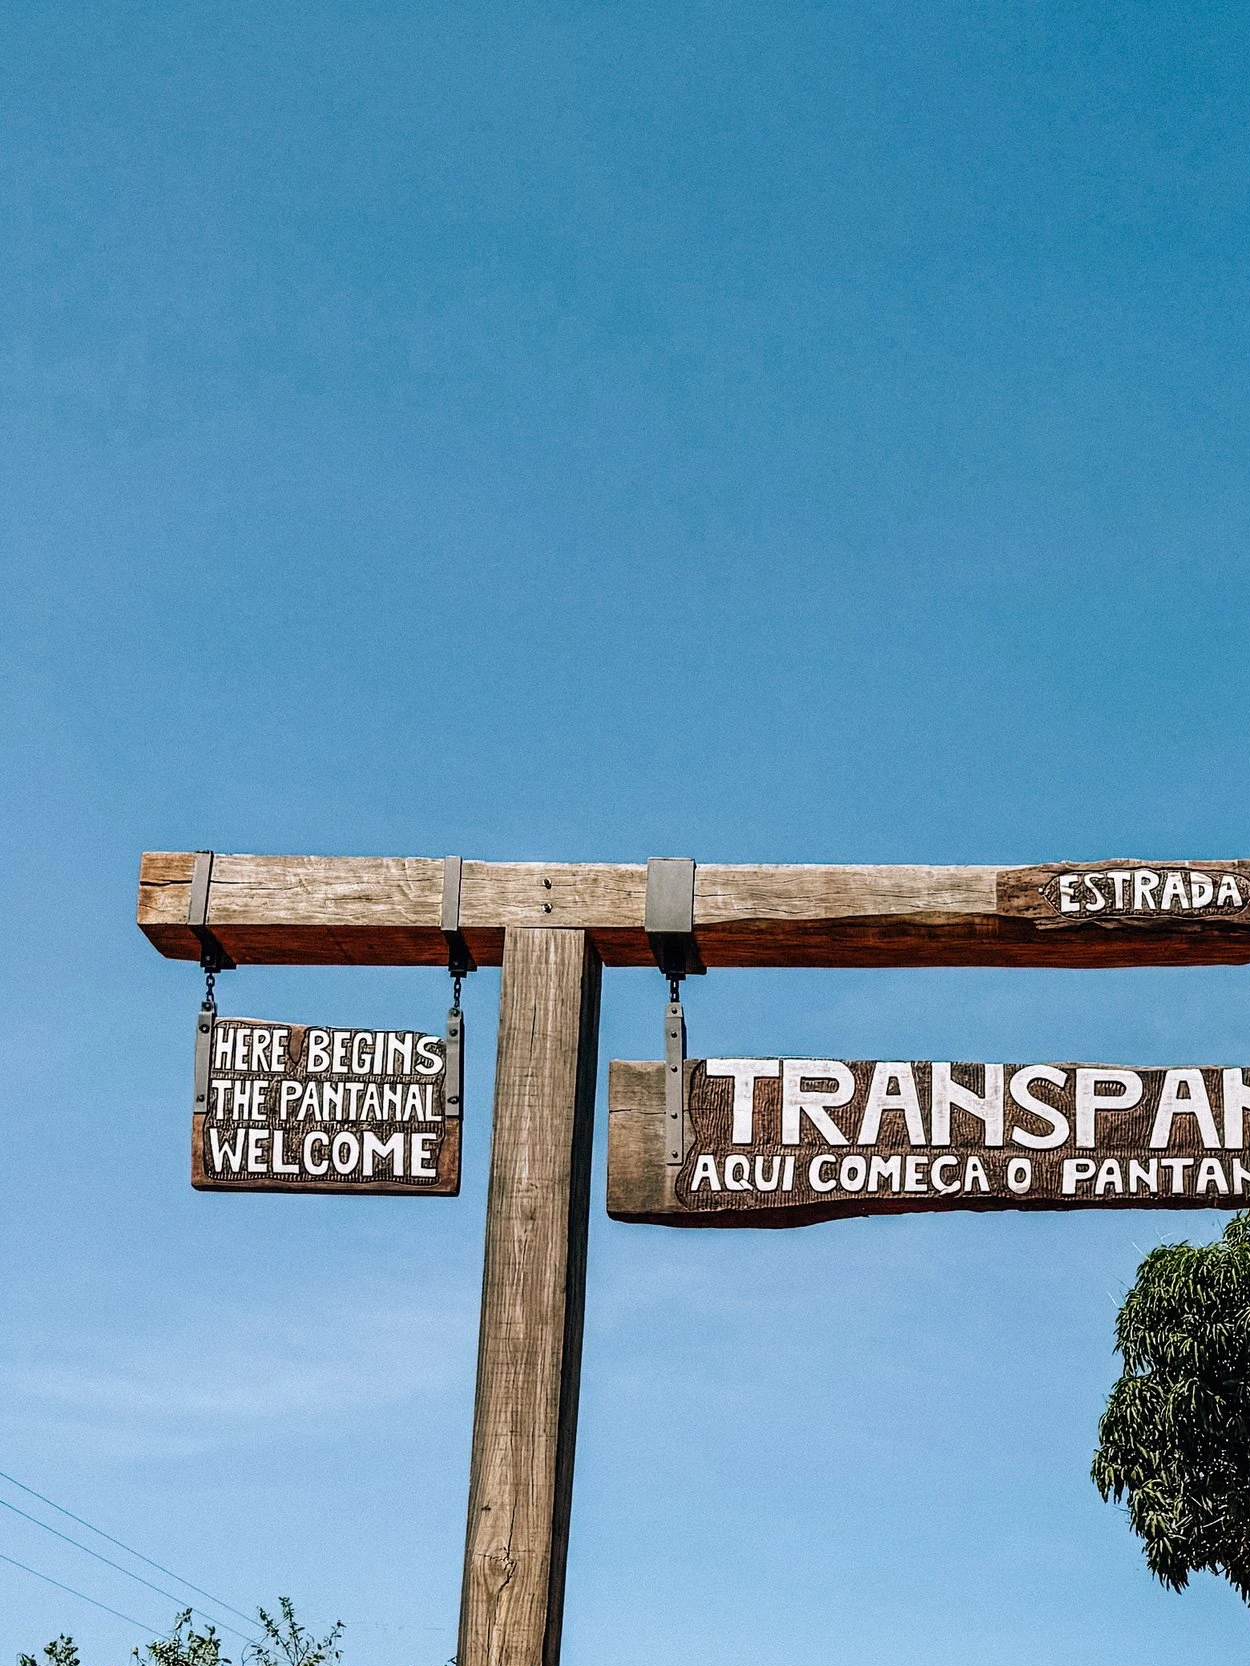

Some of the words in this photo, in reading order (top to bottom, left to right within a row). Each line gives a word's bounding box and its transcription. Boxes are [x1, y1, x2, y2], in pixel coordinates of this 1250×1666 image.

[1059, 869, 1243, 913] ESTRADA
[214, 1026, 289, 1073] HERE
[306, 1030, 444, 1075] BEGINS
[211, 1080, 269, 1121] THE
[280, 1081, 443, 1122] PANTANAL
[209, 1127, 437, 1178] WELCOME
[690, 1154, 796, 1192] AQUI
[1007, 1157, 1032, 1194] O
